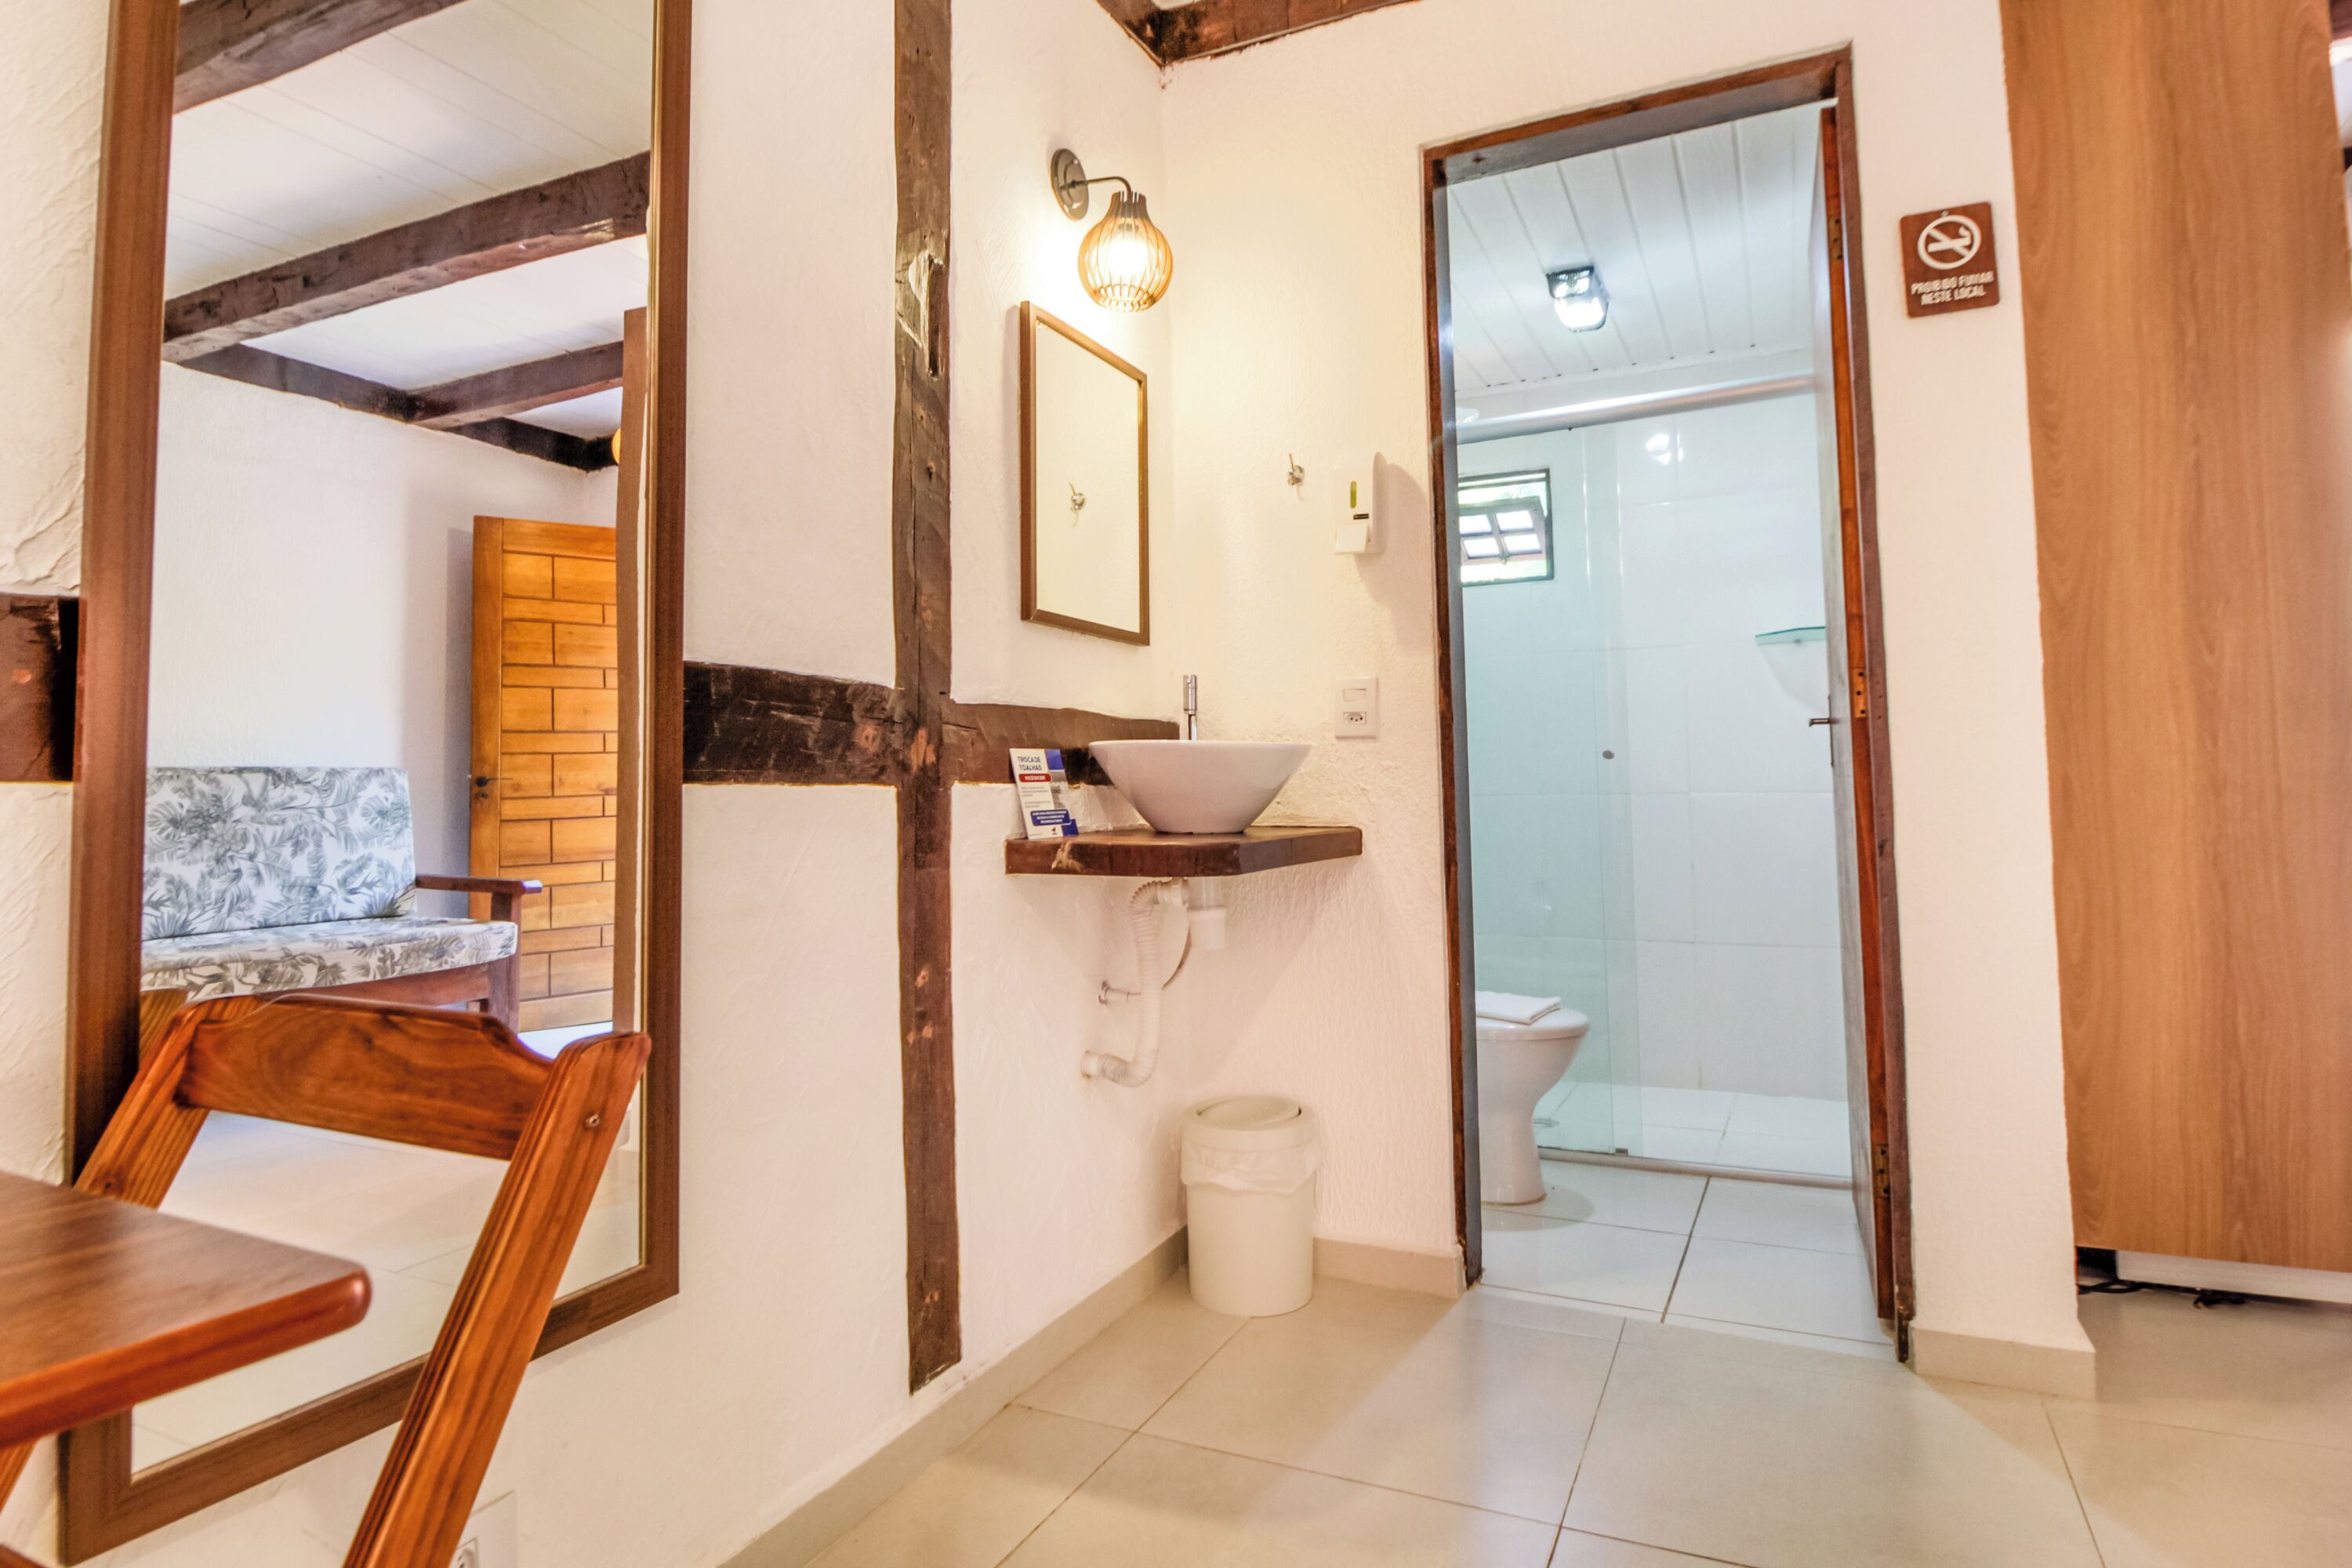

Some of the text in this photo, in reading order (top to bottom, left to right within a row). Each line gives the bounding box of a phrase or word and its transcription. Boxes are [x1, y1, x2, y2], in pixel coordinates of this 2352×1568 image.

[1911, 270, 1994, 296] PROIBIDO FUMAR
[1921, 285, 1987, 306] NESTE LOCAL
